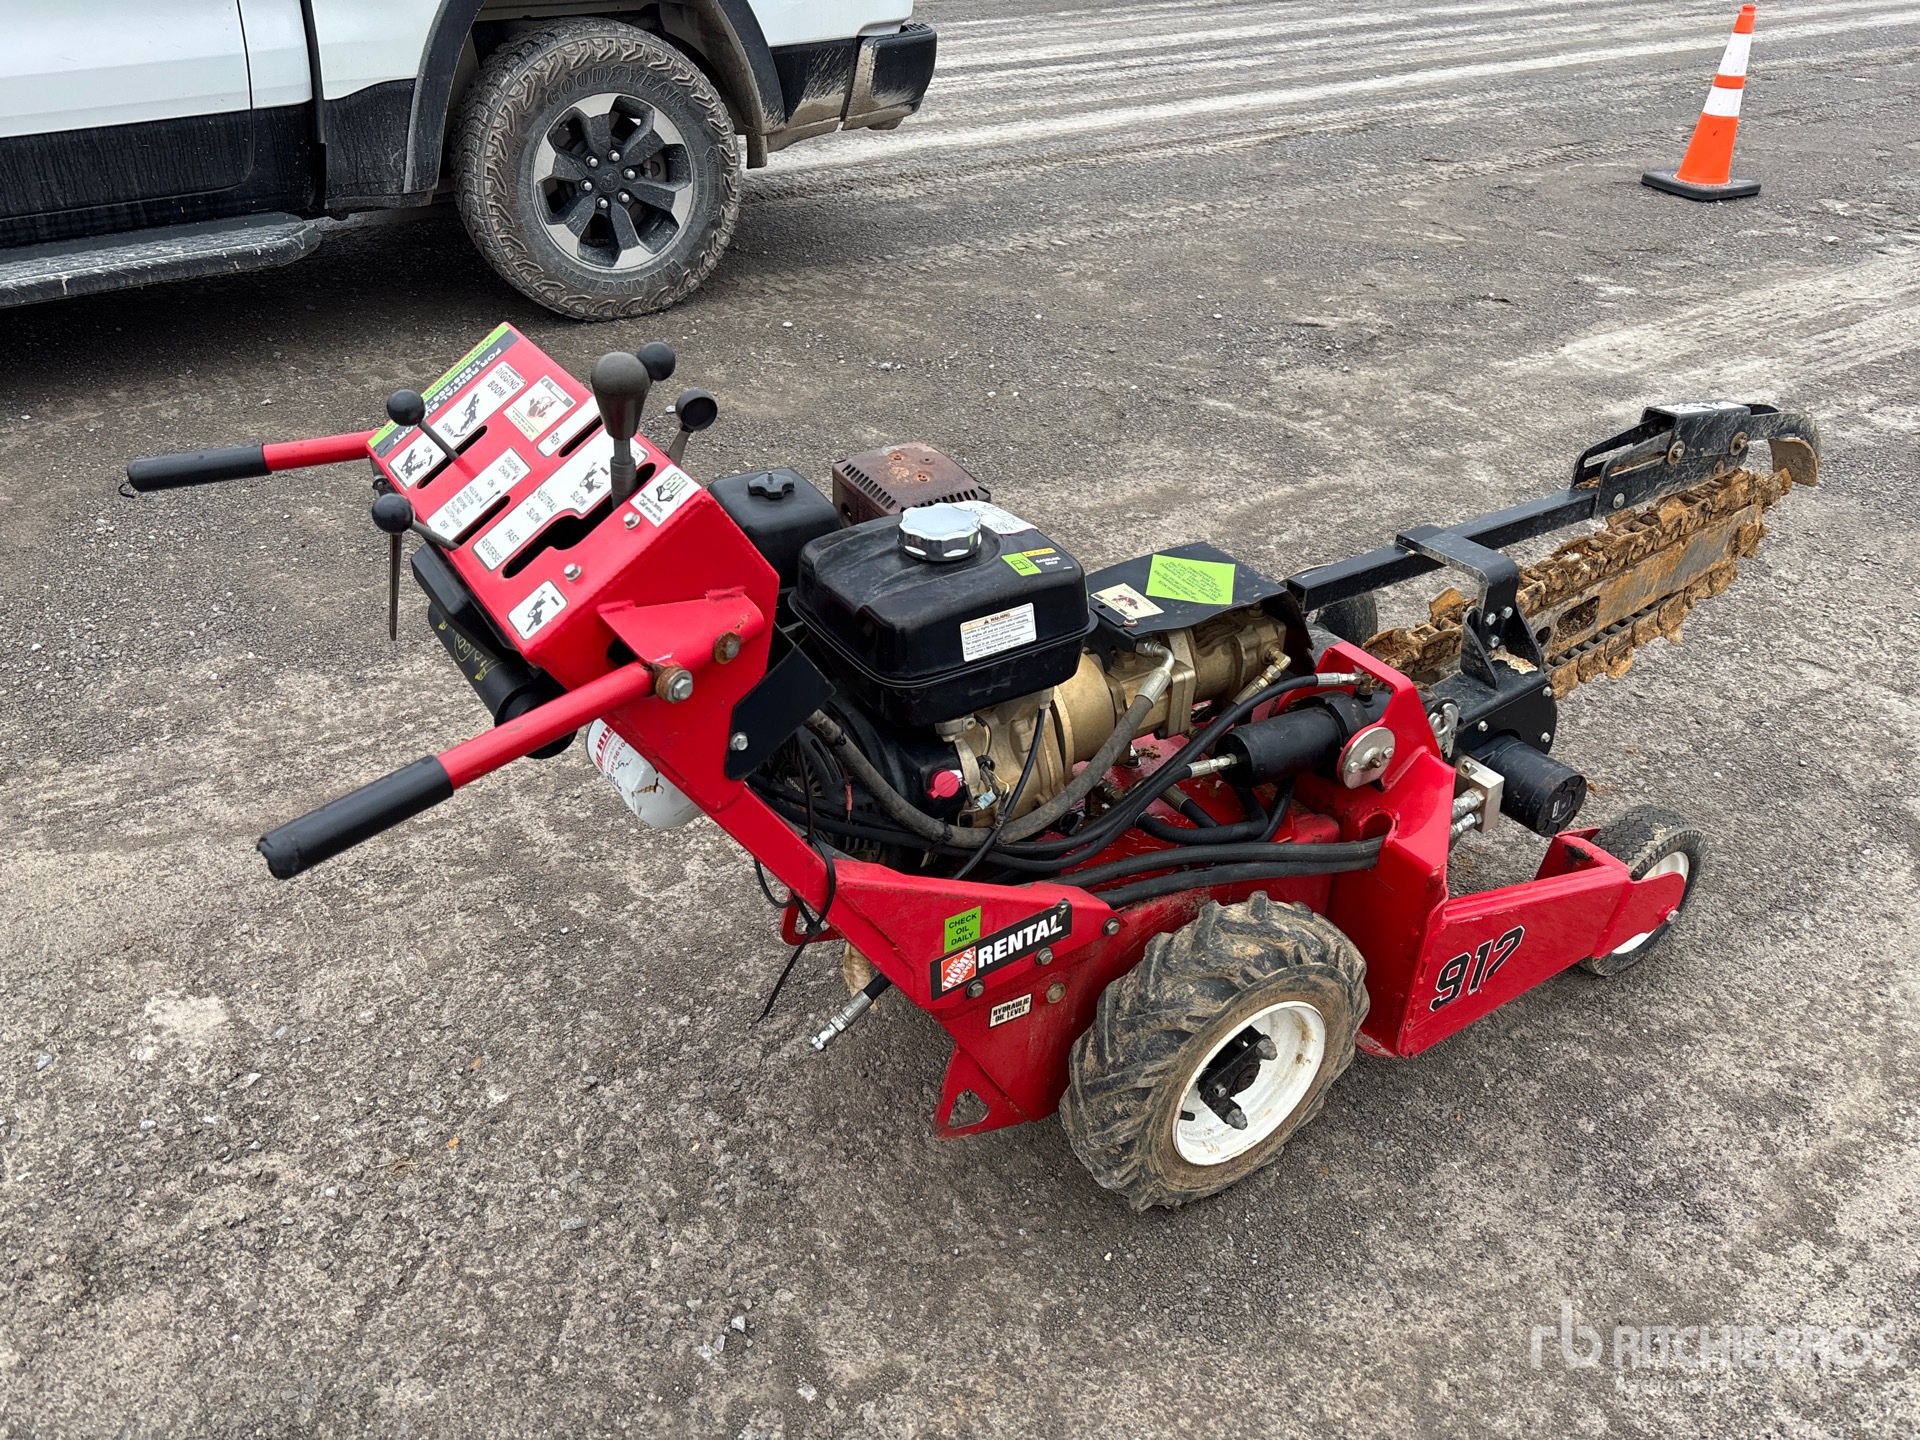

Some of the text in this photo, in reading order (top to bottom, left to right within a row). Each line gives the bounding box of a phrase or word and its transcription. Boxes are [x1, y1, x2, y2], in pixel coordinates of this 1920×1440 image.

[546, 64, 687, 108] GOODYEAR
[557, 258, 685, 296] WRANGLER
[479, 347, 502, 367] FOR
[439, 367, 478, 402] RENTAL
[494, 366, 520, 390] DIGGING
[486, 379, 506, 398] BOOM
[441, 422, 455, 436] DOWN
[498, 464, 511, 480] CHAIN
[503, 456, 521, 474] DIGGING
[486, 478, 496, 488] ON
[661, 471, 688, 497] 811
[455, 496, 468, 510] BEFORE
[535, 487, 558, 512] NEUTRAL
[570, 490, 588, 507] SLOW
[438, 519, 449, 530] OFF
[525, 507, 542, 525] SLOW
[504, 528, 519, 544] FAST
[479, 538, 502, 563] REVERSE
[948, 912, 977, 929] CHECK
[951, 932, 974, 946] DAILY
[956, 926, 970, 934] OIL
[978, 914, 1062, 968] RENTAL
[942, 949, 974, 988] HOME
[945, 958, 960, 974] THE
[955, 958, 975, 983] DEPOT
[1430, 925, 1525, 1012] 912
[992, 997, 1030, 1017] HYDRAULIC
[995, 1006, 1027, 1023] OIL LEVEL
